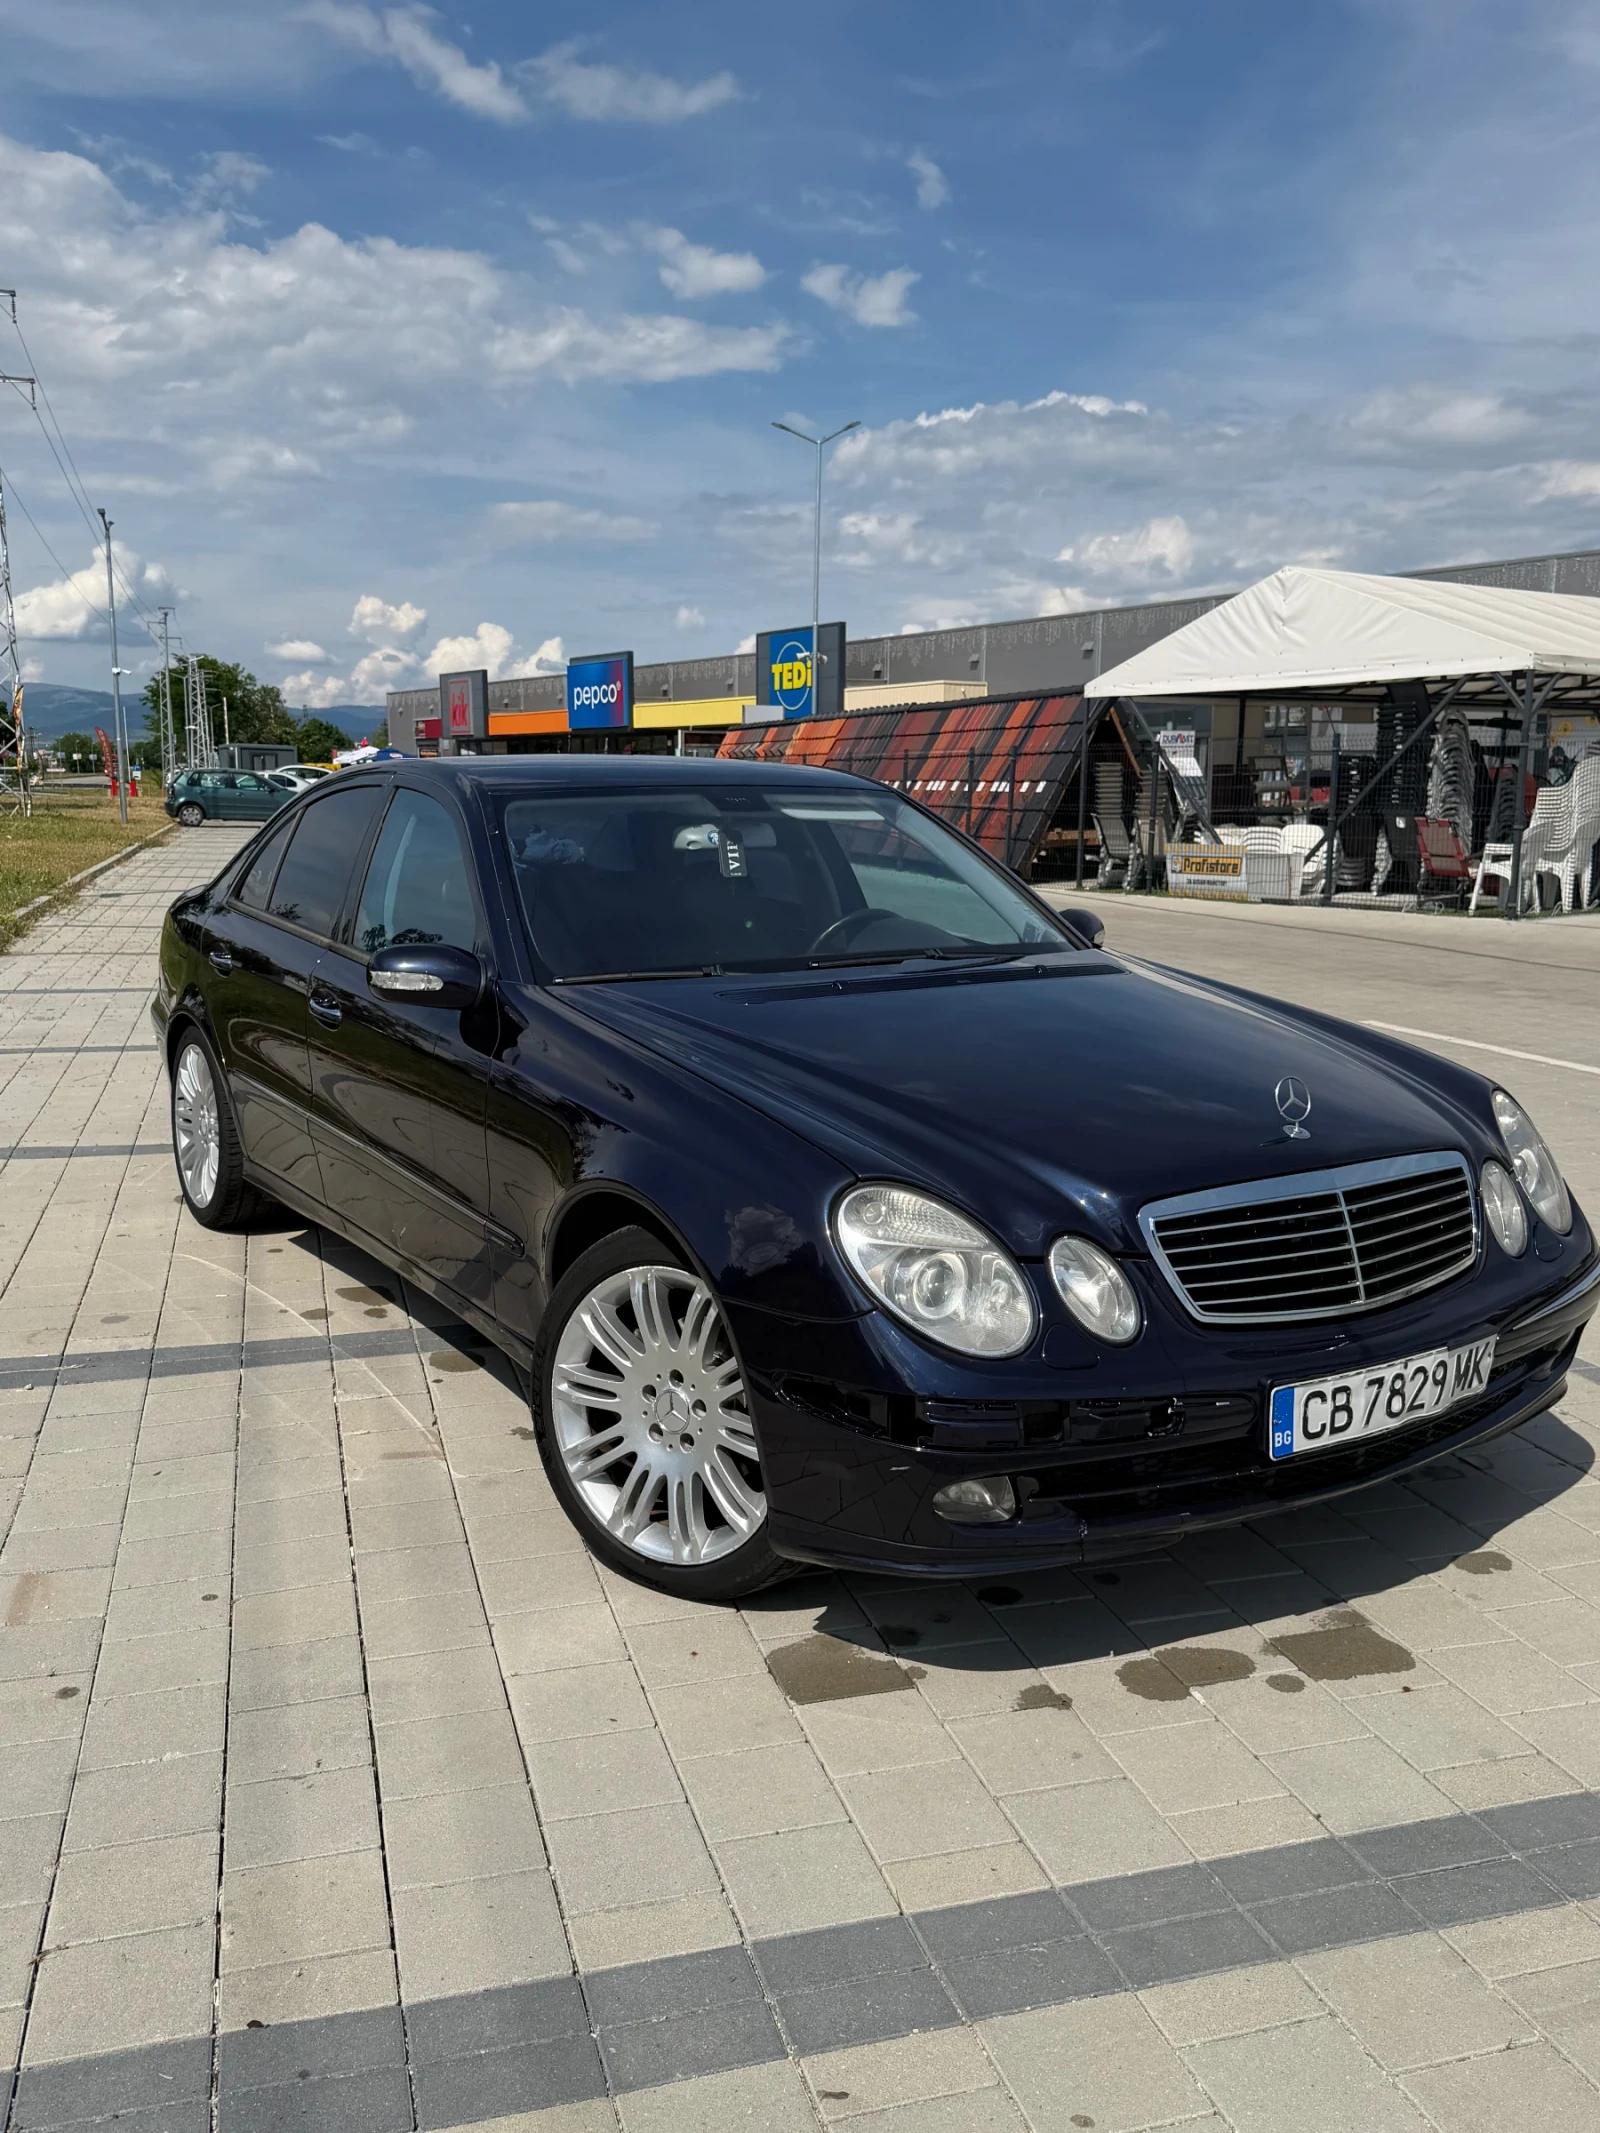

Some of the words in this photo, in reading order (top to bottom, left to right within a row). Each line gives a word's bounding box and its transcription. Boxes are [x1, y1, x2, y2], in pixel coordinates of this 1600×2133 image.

[771, 660, 812, 691] TEDi
[573, 684, 618, 710] pepco
[1183, 858, 1239, 874] Profistore
[1302, 1384, 1353, 1440] CB
[1362, 1359, 1448, 1428] 7829
[1450, 1341, 1490, 1399] MK
[1274, 1430, 1292, 1448] BG
